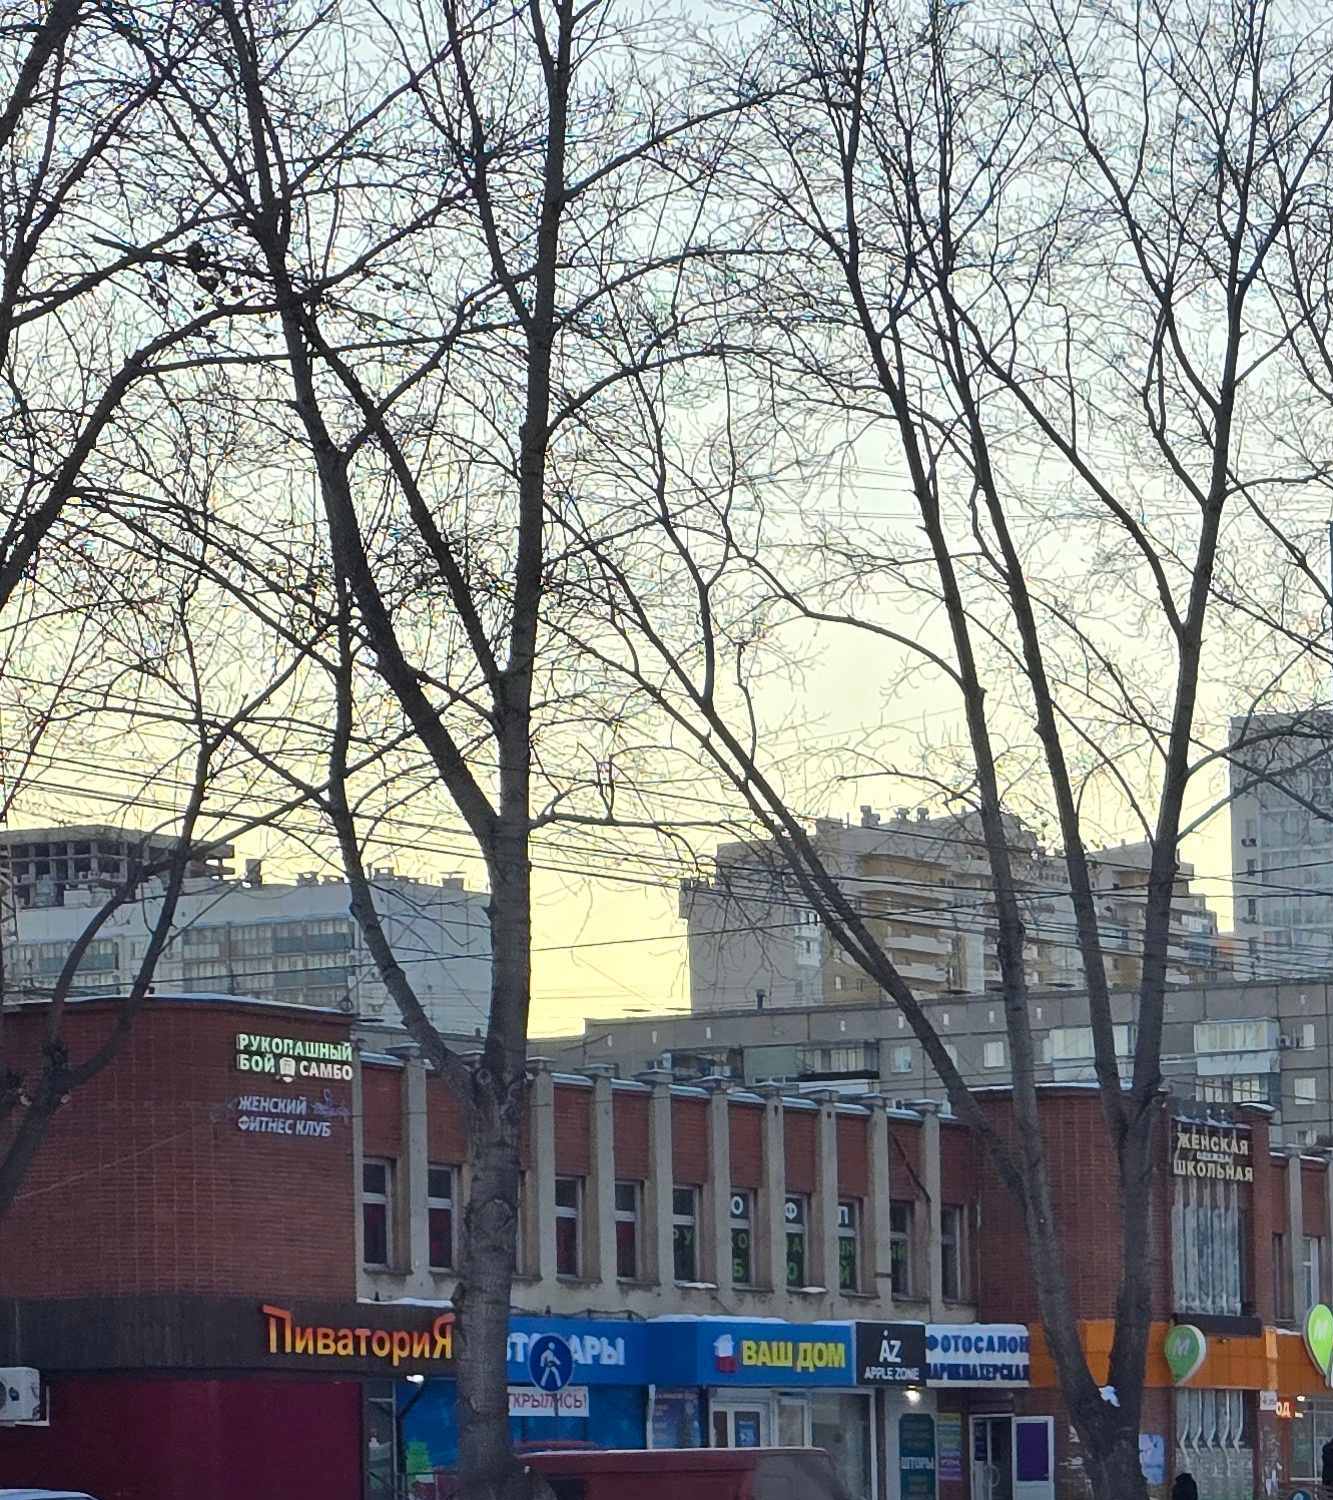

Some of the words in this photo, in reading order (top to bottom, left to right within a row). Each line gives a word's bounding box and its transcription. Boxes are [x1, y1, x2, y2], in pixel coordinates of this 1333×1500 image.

[237, 1033, 353, 1062] РУКОПАШНЫЙ
[237, 1053, 276, 1073] БОЙ
[299, 1060, 353, 1081] САМБО
[238, 1095, 307, 1115] ЖЕНСКИЙ
[238, 1115, 293, 1134] ФИТНЕС
[295, 1119, 331, 1137] КЛУБ
[1176, 1131, 1249, 1155] ЖЕНСКАЯ
[1173, 1159, 1254, 1182] ШКОЛЬНАЯ
[927, 1334, 1029, 1354] ФОТОСАЛОН
[742, 1341, 792, 1367] ВАШ
[796, 1342, 846, 1372] ДОМ
[864, 1366, 893, 1380] APPLE
[894, 1367, 920, 1381] ZONE
